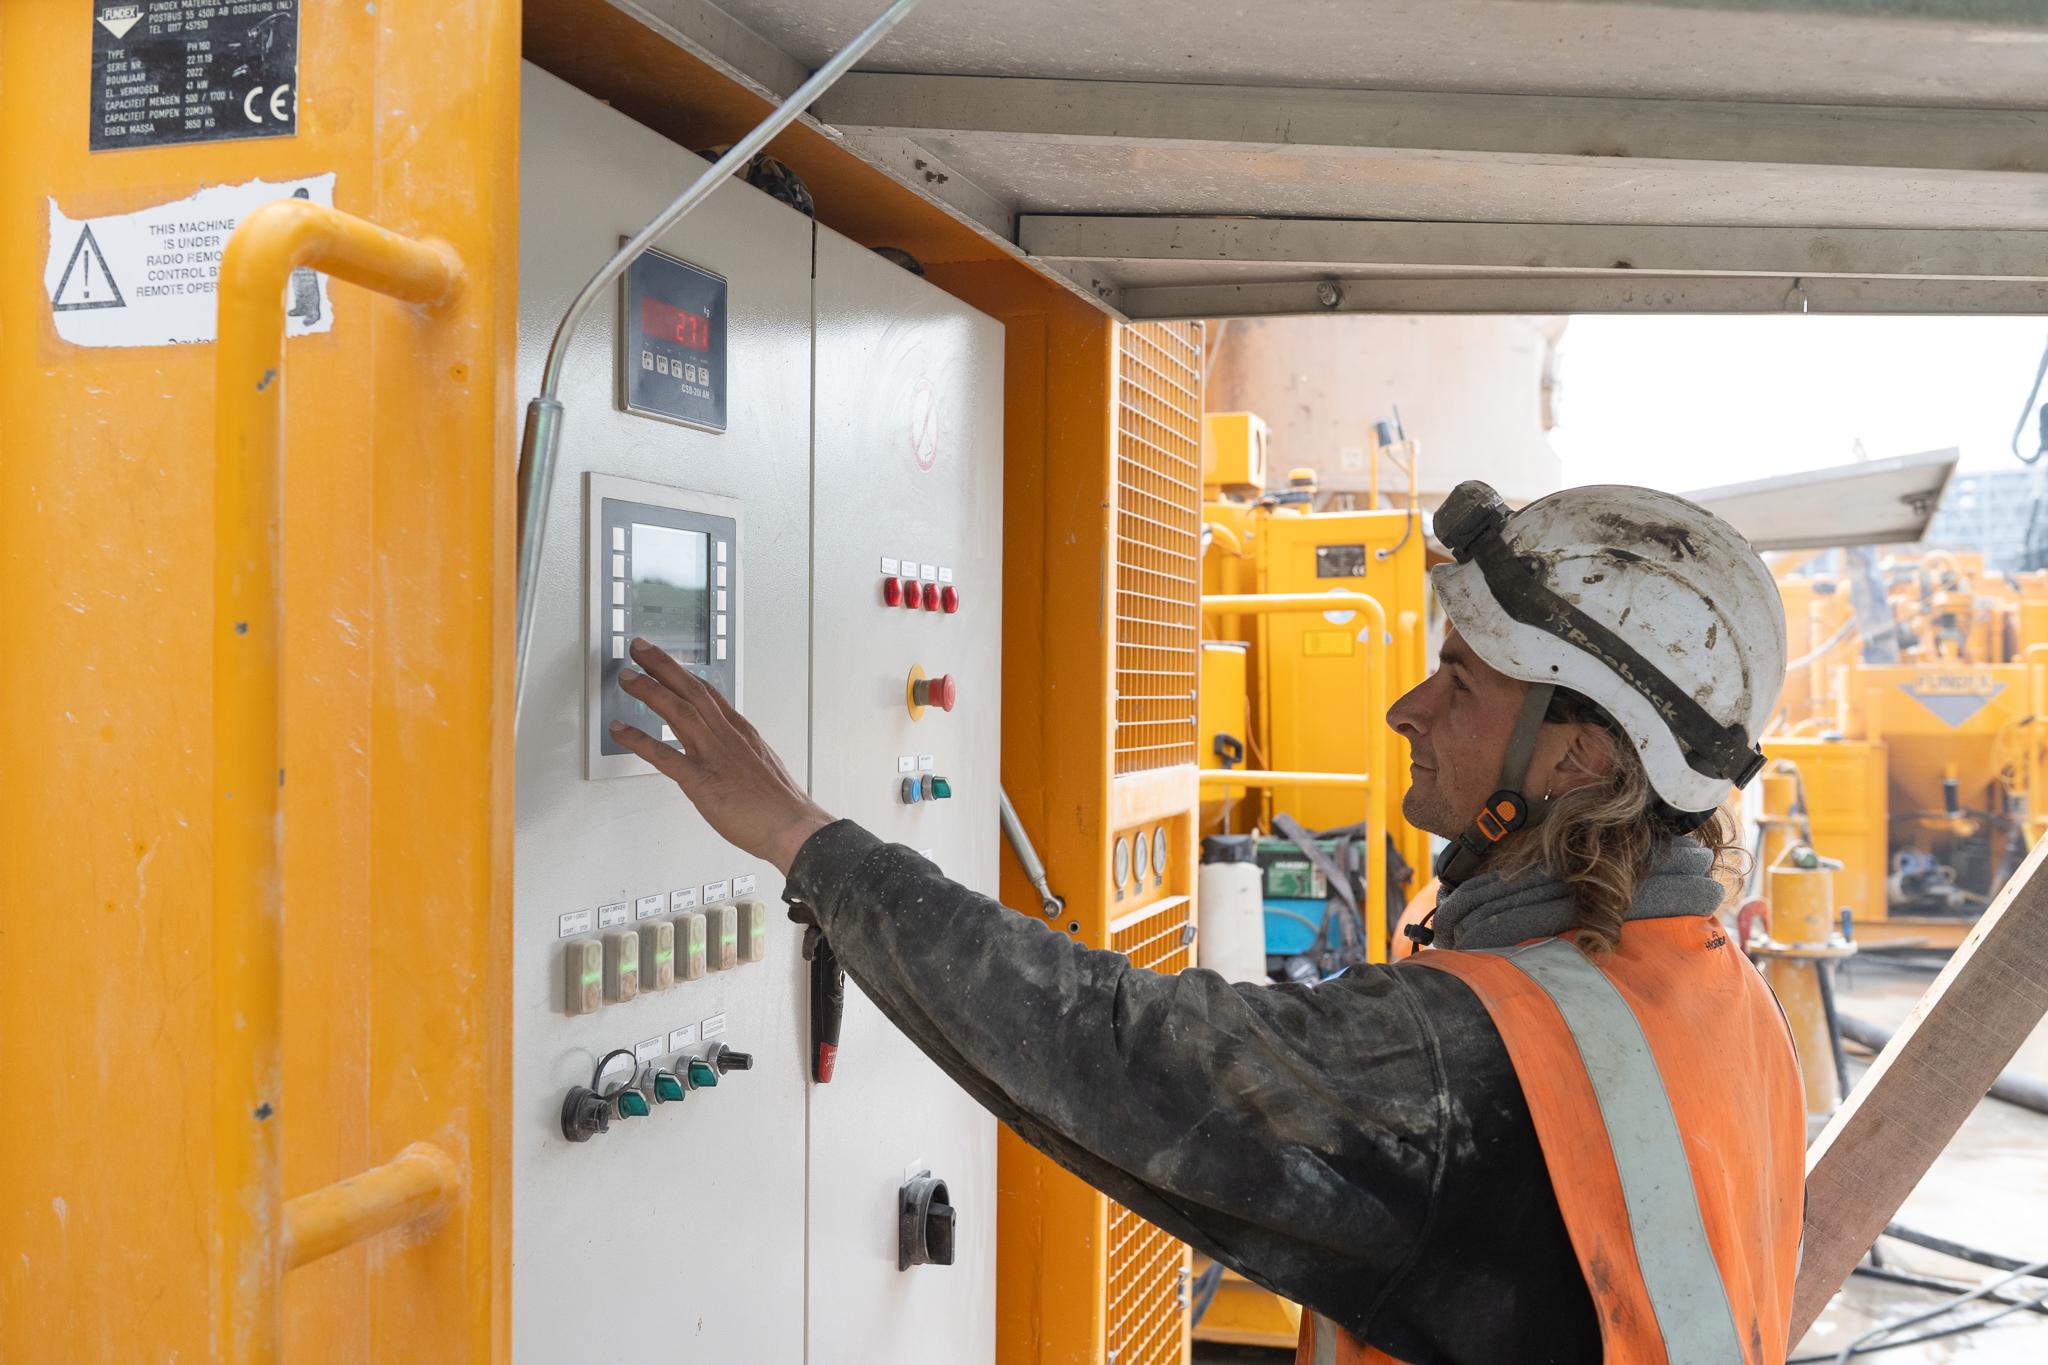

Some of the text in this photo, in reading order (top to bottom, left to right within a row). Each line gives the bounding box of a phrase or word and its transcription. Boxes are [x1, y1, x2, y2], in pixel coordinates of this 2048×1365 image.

[149, 1, 178, 12] FUNDEX
[149, 0, 293, 24] POSTBUS 55 4500 AB OOSTBURG (NL)
[105, 7, 137, 20] FUNDEX
[167, 22, 183, 32] 0117
[108, 49, 125, 59] TYPE
[106, 62, 128, 73] SERIE
[186, 67, 204, 78] 2022
[106, 73, 146, 85] BOUWJAAR
[120, 84, 159, 97] VERMOGEN
[229, 89, 235, 100] L
[105, 95, 180, 111] CAPACITEIT MENGEN
[105, 108, 180, 123] CAPACITEIT POMPEN
[104, 123, 155, 136] EIGEN MASSA
[149, 218, 235, 235] THIS MACHINE
[163, 235, 220, 250] IS UNDER
[146, 253, 184, 266] RADIO
[147, 266, 221, 281] CONTROL B
[136, 284, 184, 297] REMOTE
